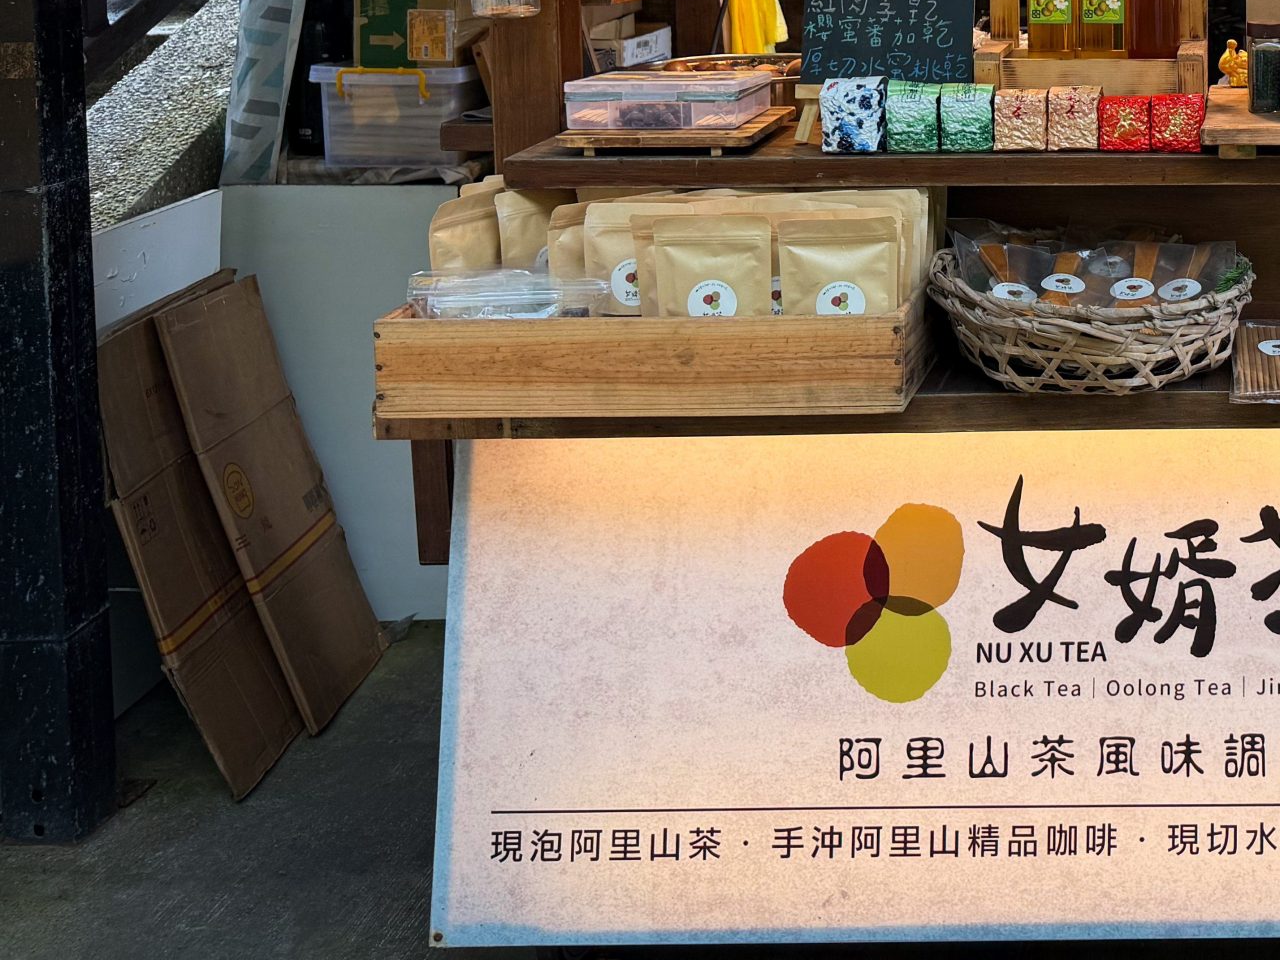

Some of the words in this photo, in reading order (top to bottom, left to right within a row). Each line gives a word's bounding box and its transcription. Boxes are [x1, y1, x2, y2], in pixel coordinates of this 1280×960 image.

[976, 642, 1013, 665] NU
[1018, 641, 1053, 664] XU
[1060, 640, 1108, 664] TEA
[974, 678, 1035, 699] Black
[1043, 679, 1082, 698] Tea
[1106, 677, 1186, 701] Oolong
[1194, 677, 1233, 697] Tea
[490, 827, 722, 864] 現泡阿里山茶
[771, 823, 1118, 860] 手沖阿里山精品咖啡
